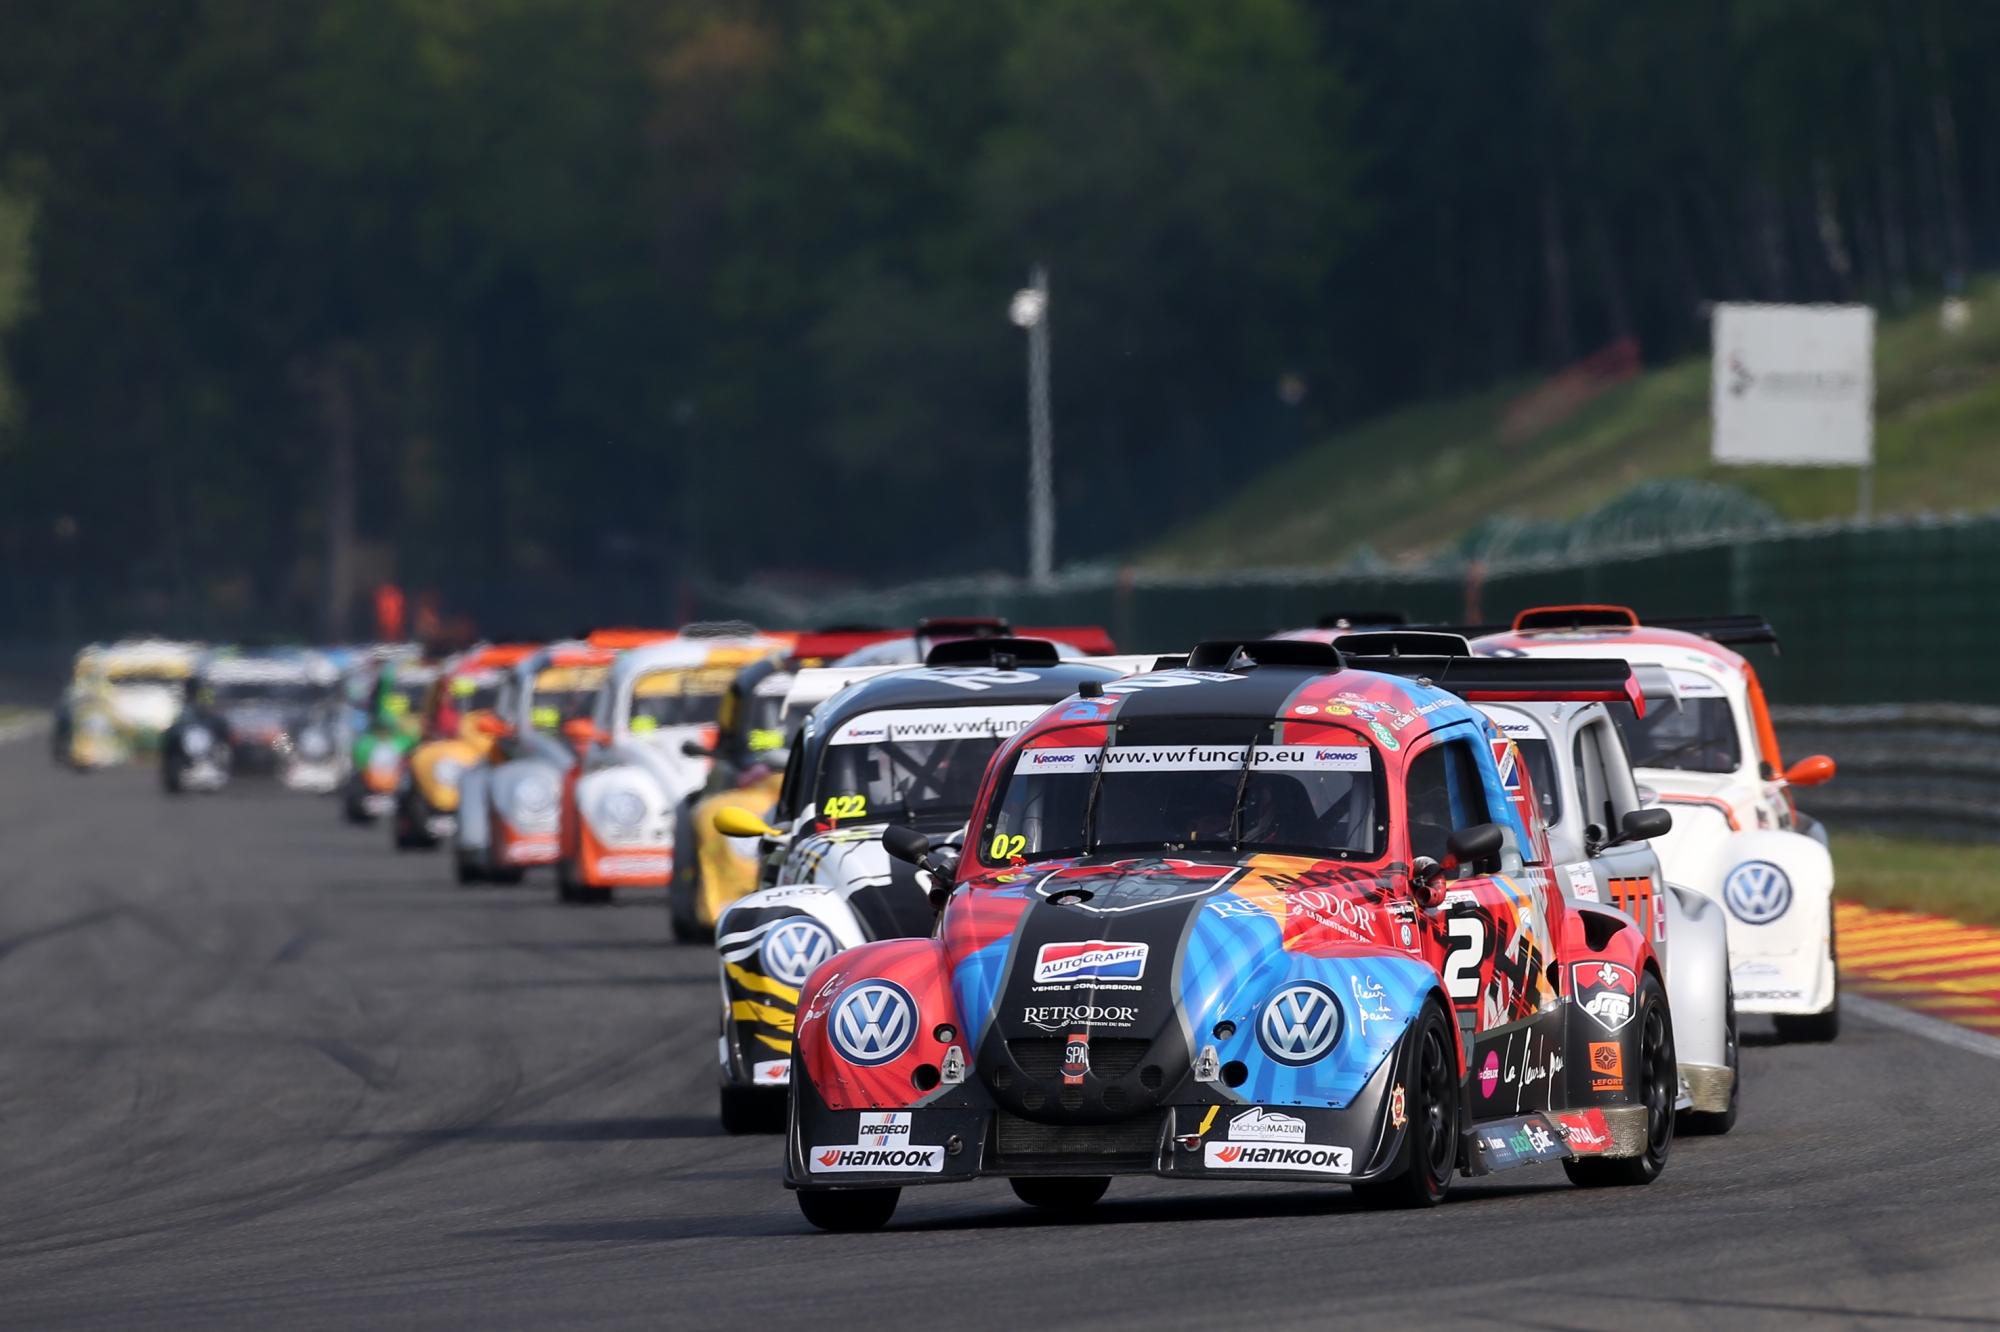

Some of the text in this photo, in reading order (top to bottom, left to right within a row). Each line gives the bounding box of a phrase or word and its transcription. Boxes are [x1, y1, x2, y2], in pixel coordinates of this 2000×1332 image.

[1033, 747, 1359, 767] KRONOS www.vwfuncup.eu KRONOS
[823, 794, 867, 819] 422
[990, 833, 1026, 859] 02
[1315, 914, 1350, 935] TRADITION
[1040, 948, 1145, 976] AUTOGRAPHE
[1073, 983, 1142, 991] CONVERSIONS
[1065, 1046, 1085, 1064] SPA
[1592, 1078, 1623, 1086] LEFORT
[859, 1124, 910, 1135] CREDECO
